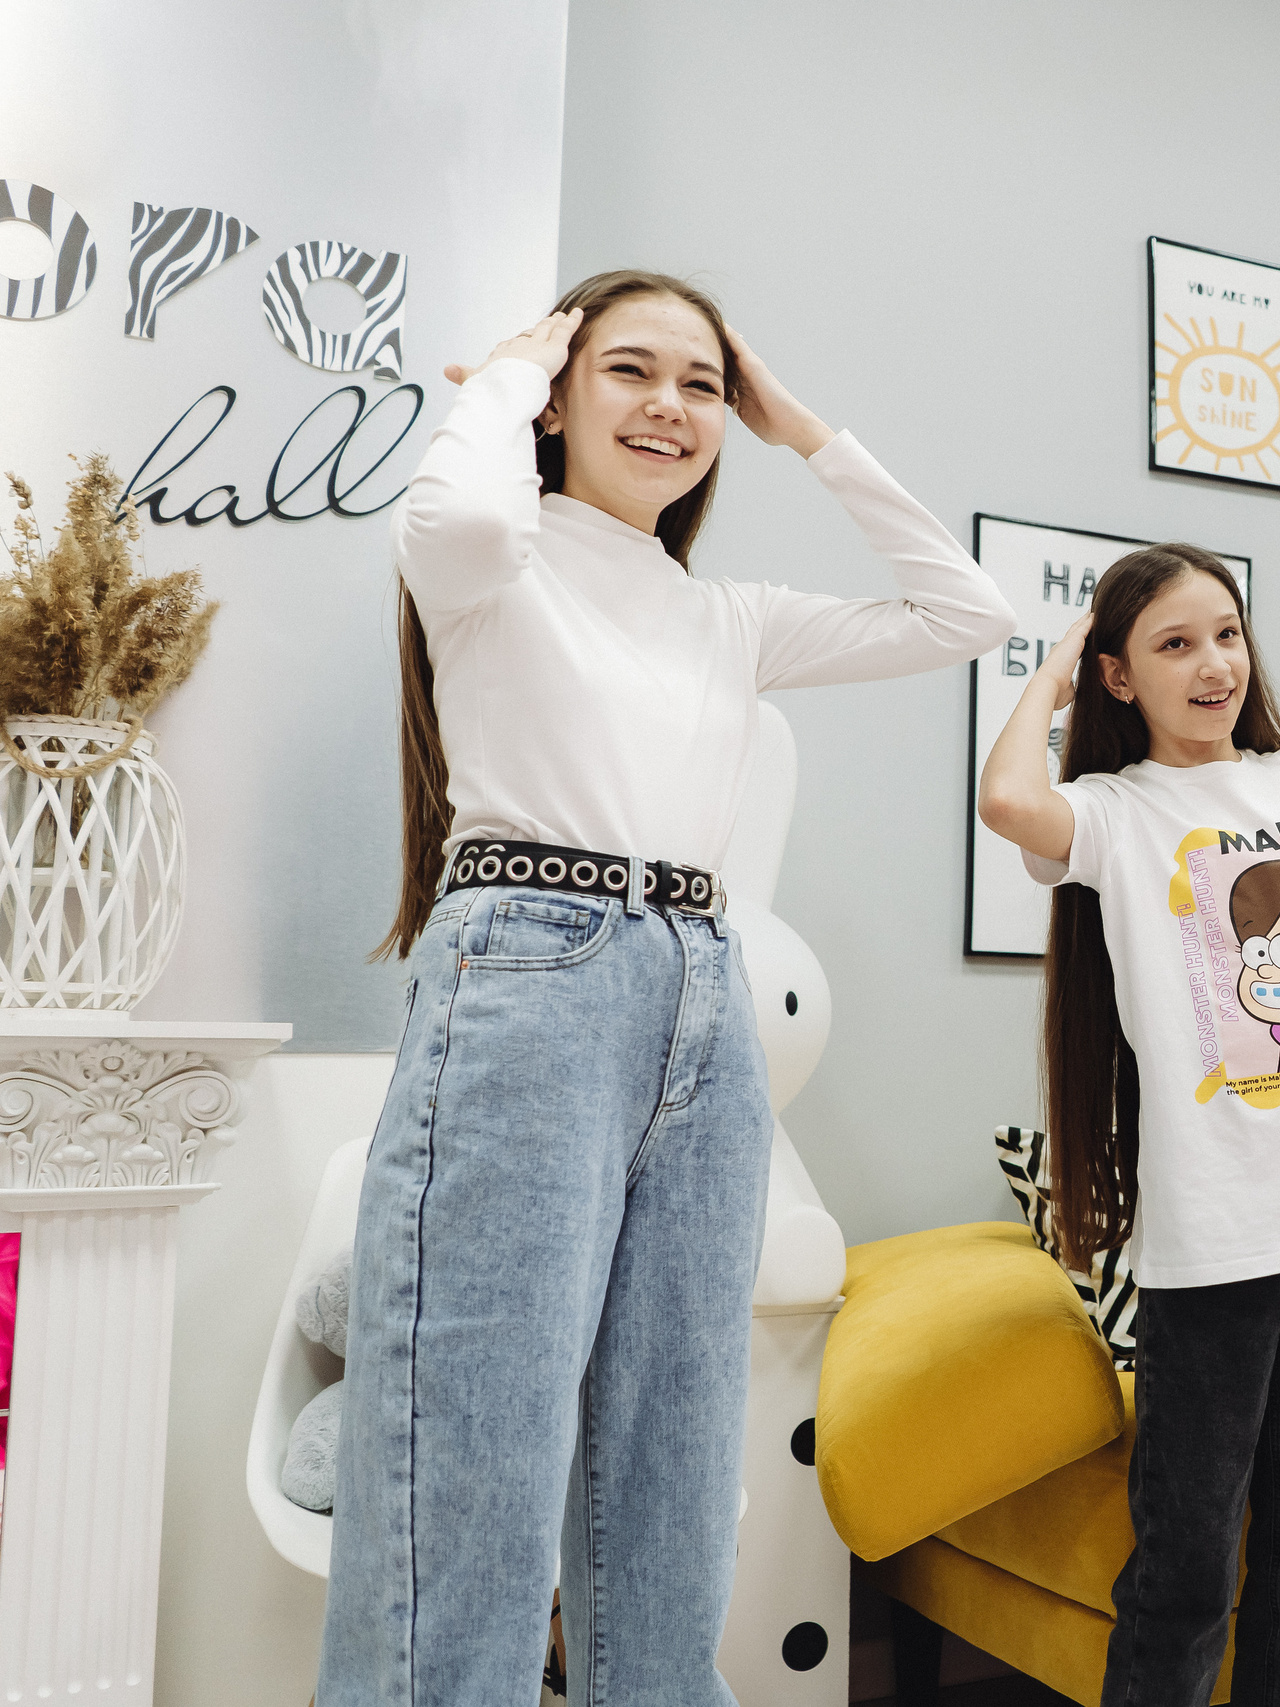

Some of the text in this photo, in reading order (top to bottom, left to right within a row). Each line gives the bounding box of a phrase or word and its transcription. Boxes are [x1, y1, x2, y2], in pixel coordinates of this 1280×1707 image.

[1188, 280, 1214, 297] YOU
[1221, 289, 1246, 304] ARE
[1200, 367, 1257, 403] SUN
[1187, 849, 1239, 1022] MONSTER HUNT!
[1177, 902, 1221, 1077] MONSTER HUNT!
[1226, 1088, 1240, 1096] the
[1240, 1086, 1253, 1096] girl
[1263, 1083, 1280, 1092] your
[1238, 1078, 1259, 1086] name
